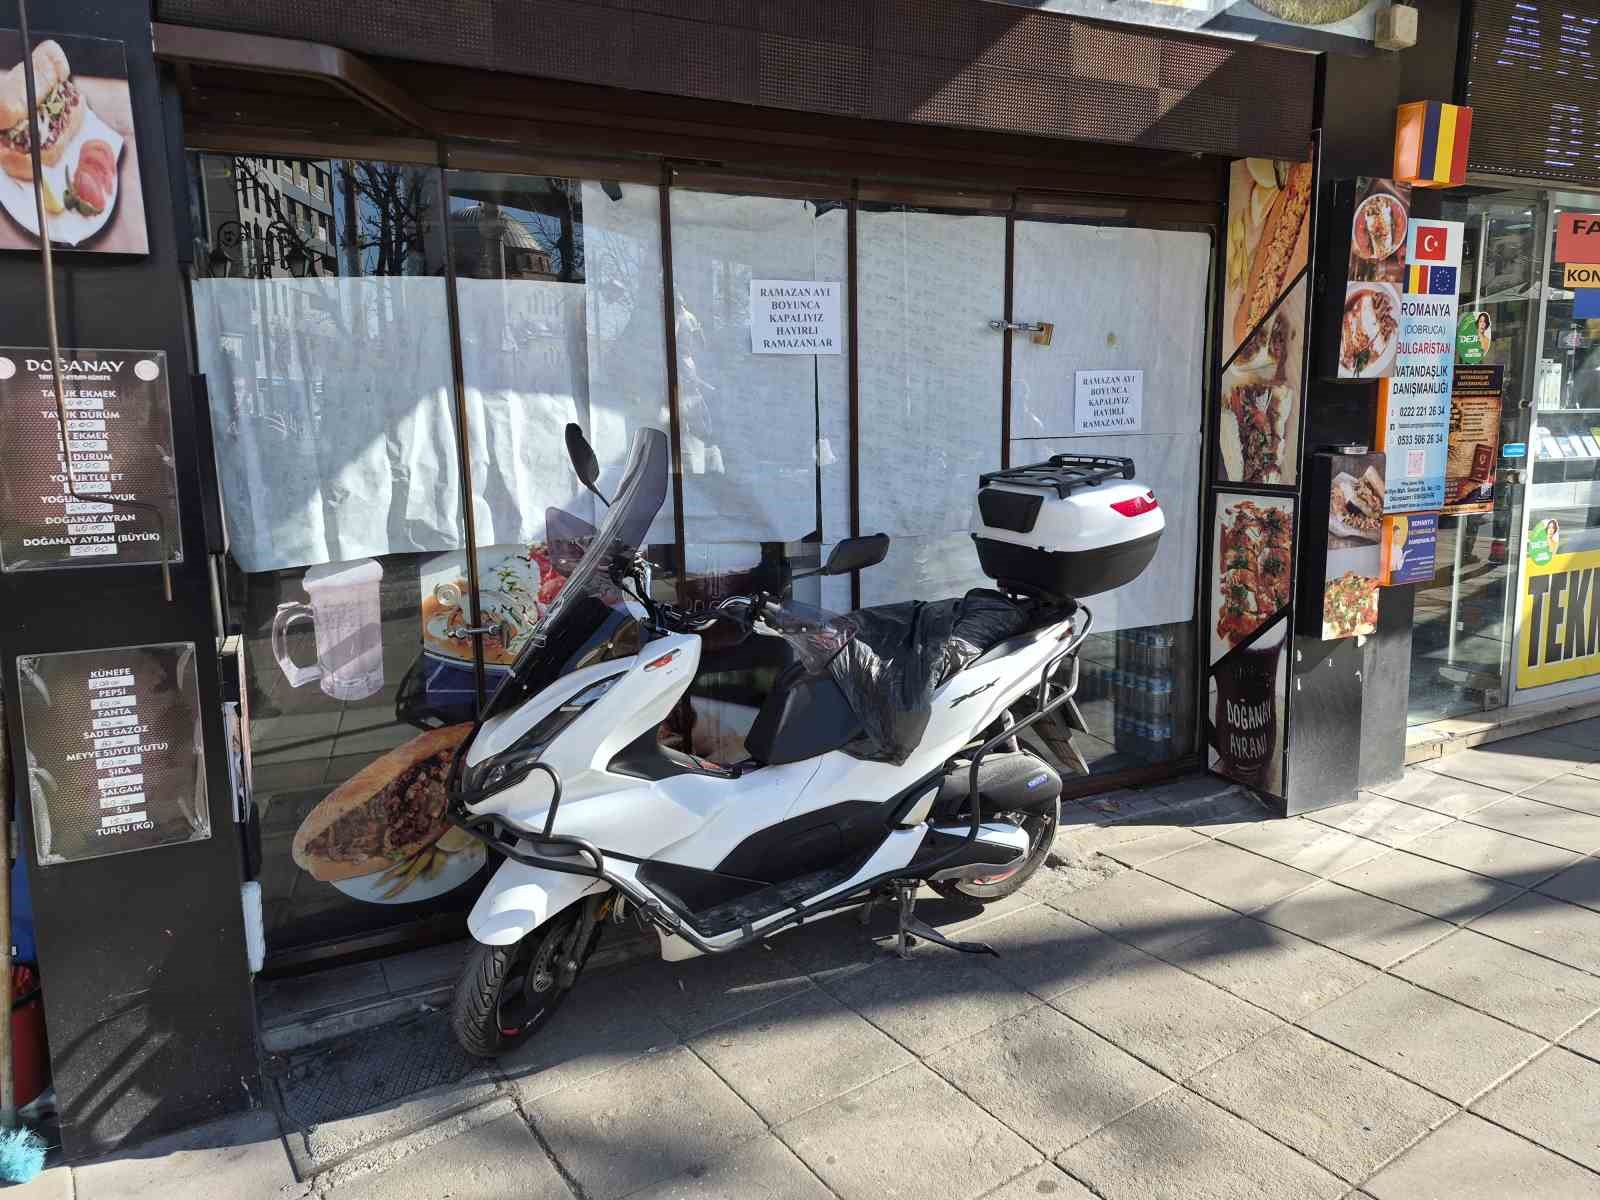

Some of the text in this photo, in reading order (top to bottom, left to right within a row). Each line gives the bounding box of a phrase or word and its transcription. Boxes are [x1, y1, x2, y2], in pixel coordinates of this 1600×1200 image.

[760, 287, 831, 297] RAMAZAN AYI
[771, 300, 821, 310] BOYUNCA
[1401, 302, 1451, 317] ROMANYA
[769, 313, 824, 323] KAPALIYIZ
[776, 326, 818, 336] HAYIRLI
[1404, 324, 1446, 336] (DOBRUCA)
[763, 337, 832, 349] RAMAZANLAR
[1395, 365, 1448, 379] VATANDAŞLIK
[1083, 375, 1135, 385] RAMAZAN AYI
[41, 389, 117, 398] TAUK EKMEK
[1090, 386, 1128, 396] BOYUNCA
[1088, 397, 1129, 407] KAPALIYIZ
[1093, 407, 1125, 417] HAYIRLI
[1400, 406, 1415, 417] 0222
[1416, 406, 1427, 417] 221
[1083, 417, 1135, 429] RAMAZANLAR
[72, 431, 110, 440] EKMEK
[1397, 434, 1413, 446] 0533
[50, 473, 123, 481] YOURTLU ET
[101, 513, 136, 522] AYRAN
[23, 531, 160, 547] DOĞANAY AYRAN (BÜYÜK)
[98, 708, 132, 717] FANTA
[1226, 697, 1272, 730] DOĞANAY
[83, 725, 150, 739] SADE GAZOZ
[66, 751, 102, 761] MEYVE
[103, 747, 131, 757] SUYU
[133, 742, 169, 754] (KUTU)
[96, 824, 130, 836] TURŞU
[132, 820, 154, 831] (KG)
